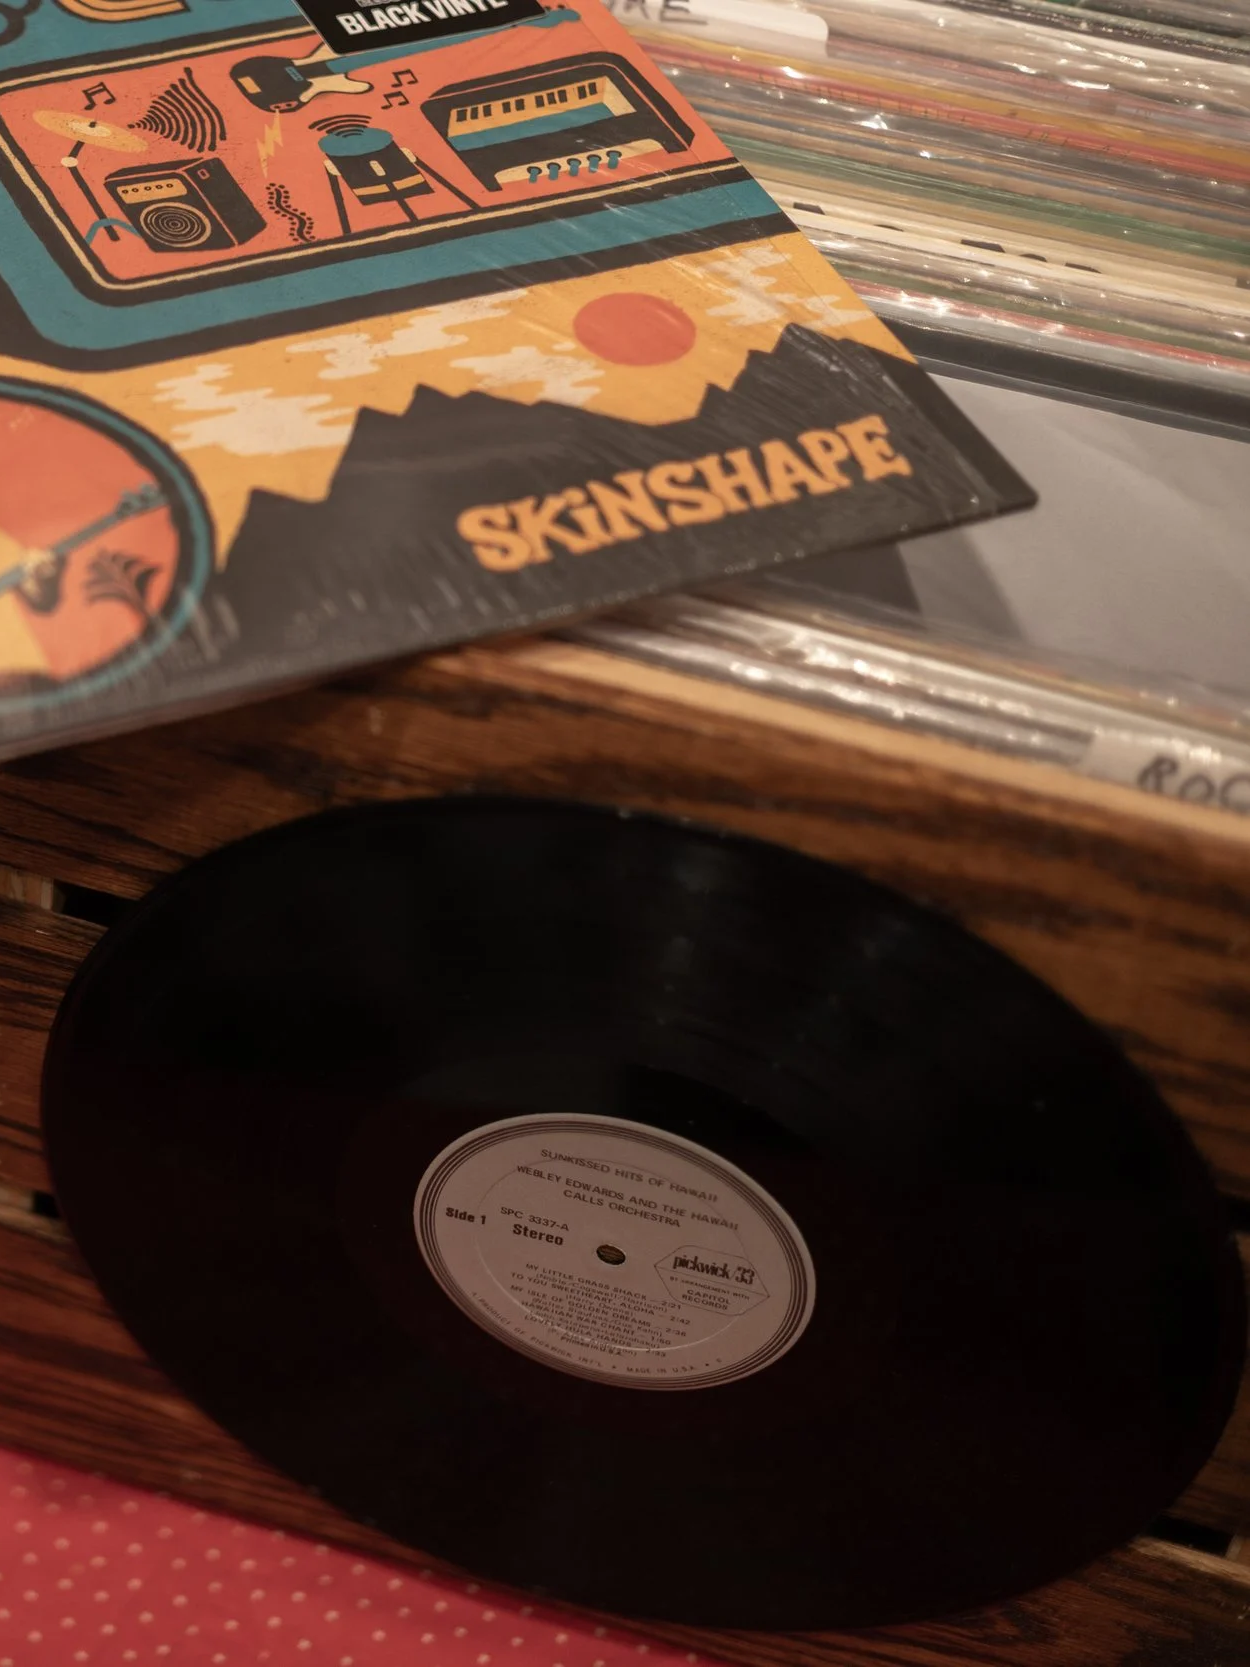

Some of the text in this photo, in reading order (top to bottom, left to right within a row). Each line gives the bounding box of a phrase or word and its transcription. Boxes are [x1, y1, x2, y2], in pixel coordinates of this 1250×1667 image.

[335, 3, 431, 35] BLACK
[540, 1148, 610, 1174] SUNKISSED
[614, 1168, 644, 1182] HITS
[648, 1177, 666, 1188] OF
[517, 1165, 561, 1183] WEBLEY
[565, 1178, 625, 1201] EDWARDS
[629, 1195, 658, 1209] AND
[662, 1204, 686, 1217] THE
[445, 1206, 487, 1225] Side 1
[500, 1206, 570, 1231] SPC 3337-A
[563, 1189, 681, 1228] CALLS ORCHESTRA
[512, 1223, 564, 1246] Stereo
[525, 1263, 539, 1271] MY
[542, 1267, 574, 1281] LITTLE
[577, 1276, 610, 1291] GRASS
[613, 1286, 648, 1302] SHACK
[527, 1276, 547, 1287] YOU
[619, 1301, 655, 1316] ALOHA
[686, 1289, 731, 1305] CAPITOL
[681, 1294, 729, 1311] RECORDS
